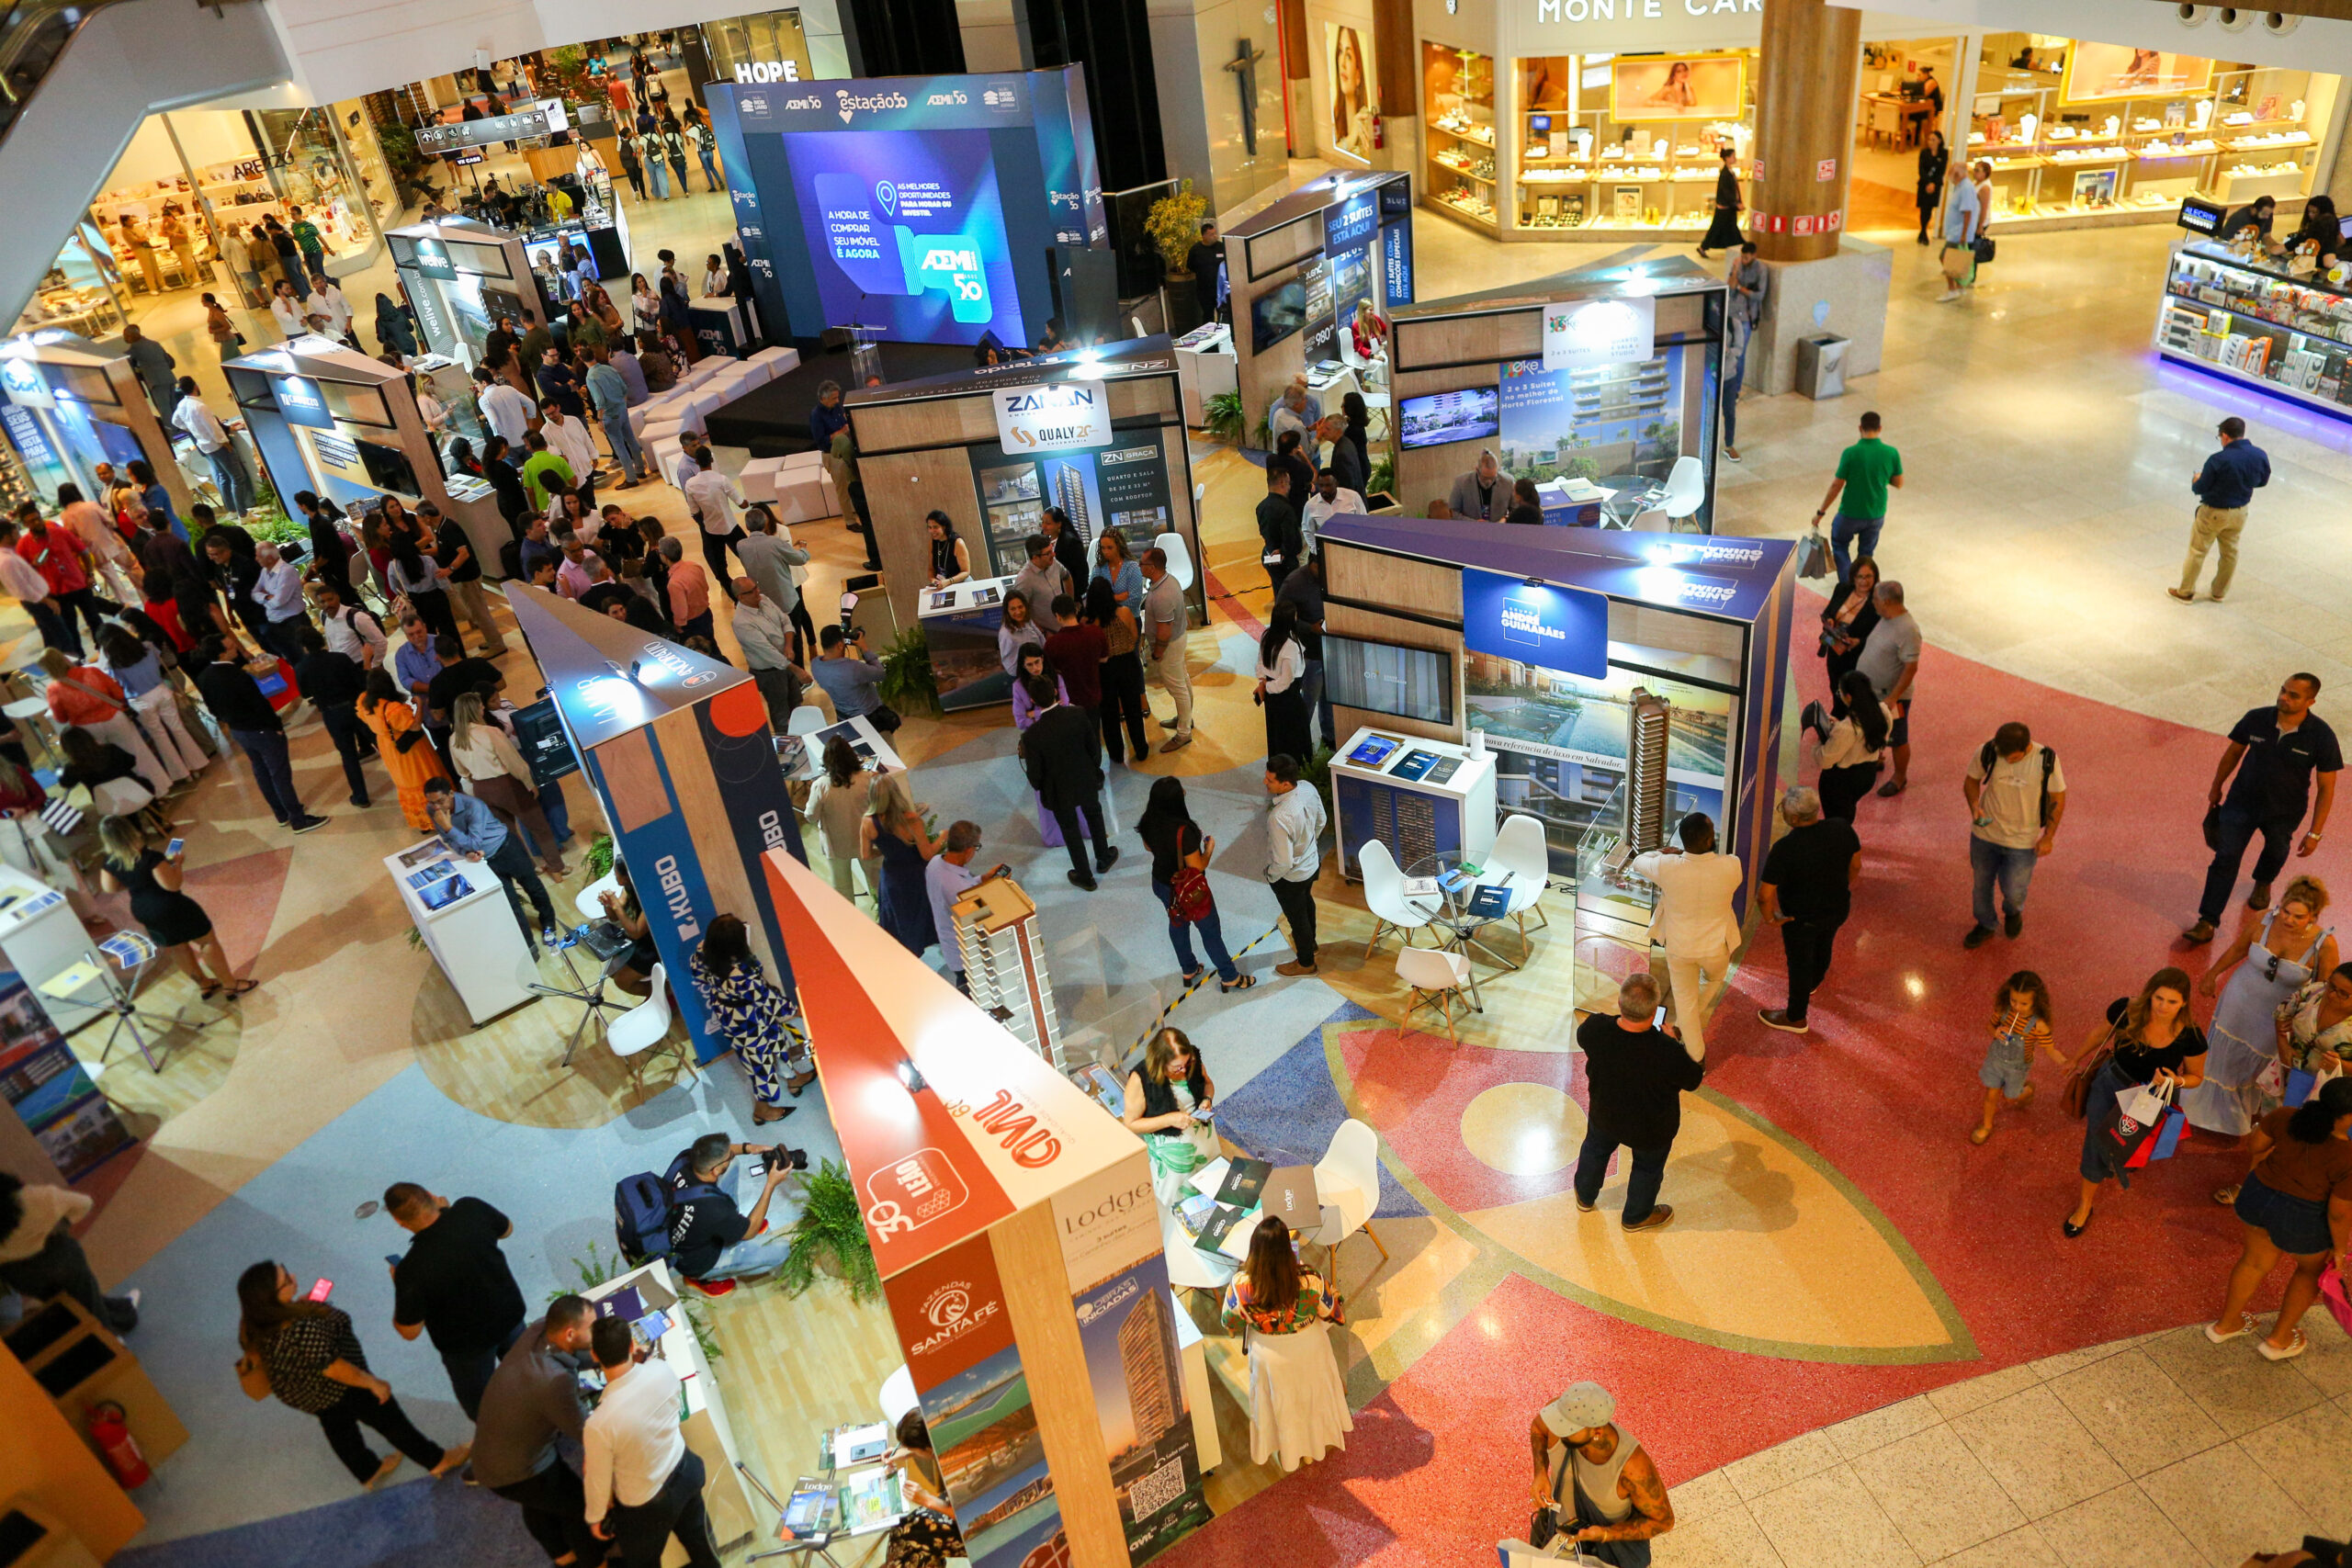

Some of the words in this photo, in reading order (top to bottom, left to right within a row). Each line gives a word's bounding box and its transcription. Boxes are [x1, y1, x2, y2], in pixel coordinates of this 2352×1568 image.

[735, 61, 798, 84] HOPE
[233, 152, 294, 179] AREZZO
[906, 183, 941, 191] MELHORES
[829, 211, 834, 220] A
[835, 210, 858, 220] HORA
[859, 211, 870, 220] DE
[1329, 218, 1342, 232] SEU
[1342, 214, 1349, 227] 2
[1349, 205, 1374, 224] SUÍTES
[831, 224, 870, 233] COMPRAR
[1332, 228, 1350, 244] ESTÁ
[1351, 220, 1371, 238] AQUI
[833, 237, 849, 246] SEU
[850, 235, 880, 246] IMÓVEL
[418, 253, 448, 269] welive
[836, 246, 844, 258] É
[845, 248, 880, 259] AGORA
[953, 274, 982, 300] 50
[974, 360, 1033, 375] Tenda
[1501, 400, 1524, 410] Horto
[1526, 395, 1564, 407] Florestal
[1517, 390, 1541, 400] melhor
[1039, 426, 1074, 441] QUALY
[1102, 453, 1123, 463] ZN
[1125, 450, 1154, 458] GRAÇA
[1107, 474, 1131, 482] QUARTO
[1125, 492, 1153, 501] ROOFTOP
[1501, 609, 1540, 626] ANDRÉ
[1501, 618, 1566, 639] GUIMARÃES
[1485, 738, 1502, 746] nova
[1503, 740, 1542, 753] referência
[1544, 748, 1553, 756] de
[1553, 749, 1570, 759] luxo
[1571, 753, 1584, 761] em
[1584, 754, 1622, 769] Salvador.
[759, 810, 787, 851] UBO
[655, 854, 693, 919] KUBO
[896, 1159, 933, 1198] LEÃO
[1066, 1181, 1151, 1235] Lodge
[920, 1281, 972, 1314] FAZENDAS
[1093, 1280, 1131, 1308] OBRAS
[1082, 1285, 1136, 1325] INICIADAS
[911, 1317, 974, 1356] SANTA
[974, 1301, 999, 1322] FÉ
[804, 1482, 832, 1492] Lodge
